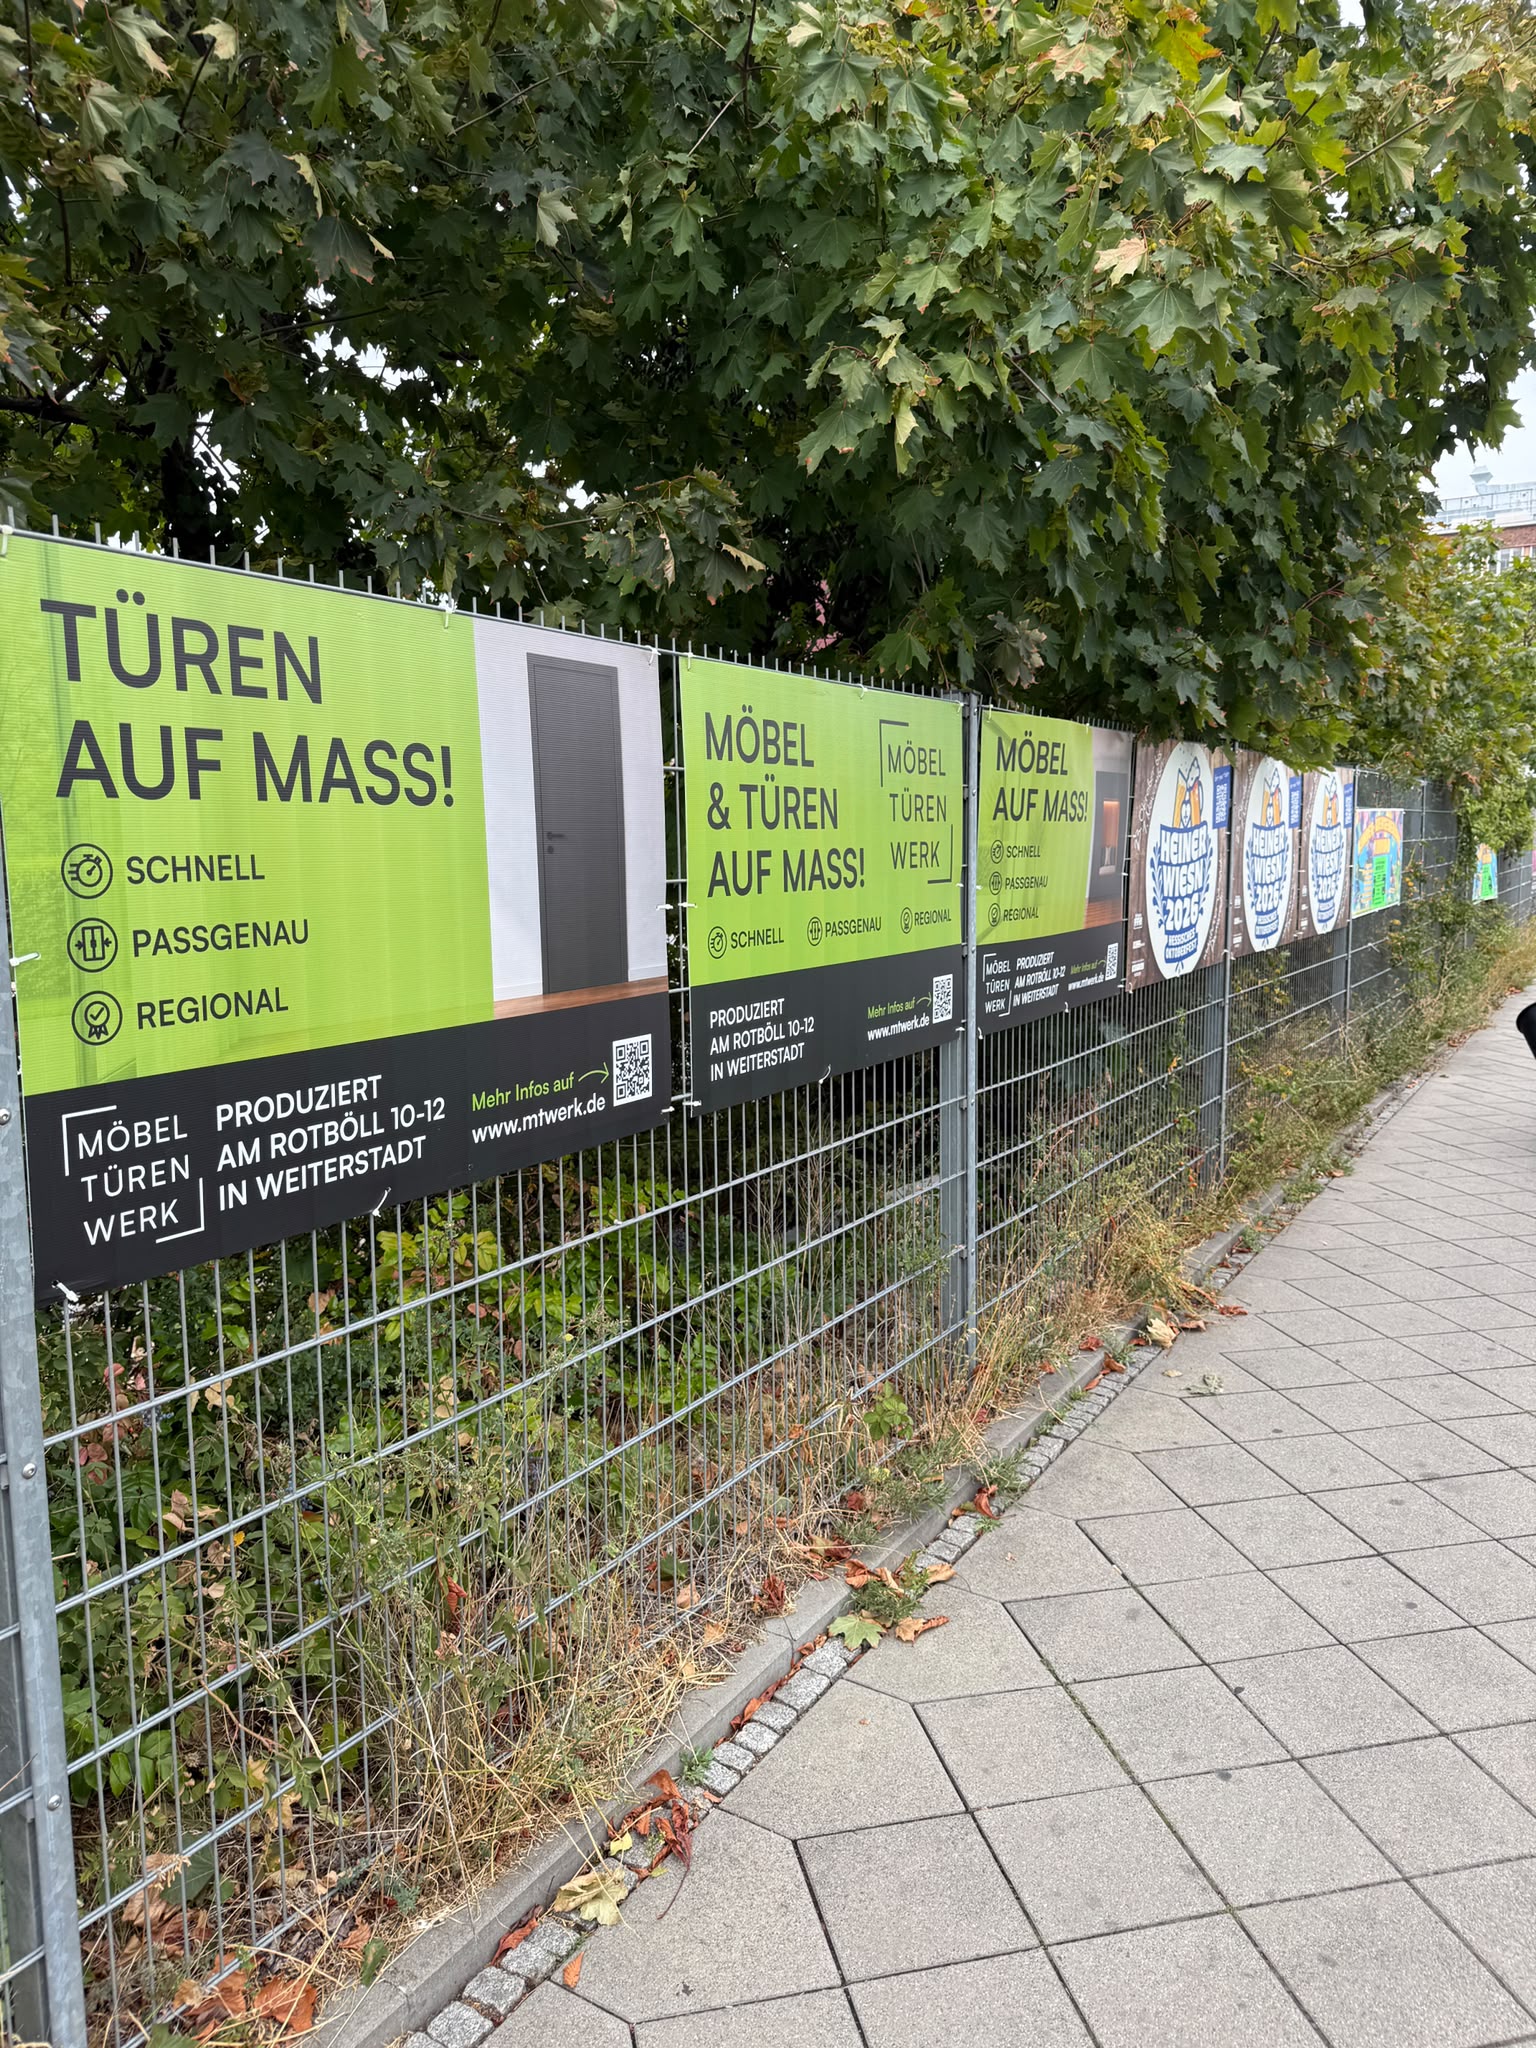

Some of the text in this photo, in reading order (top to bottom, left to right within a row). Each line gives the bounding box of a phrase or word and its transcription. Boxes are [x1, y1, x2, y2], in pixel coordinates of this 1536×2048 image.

[39, 589, 323, 705] TÜREN
[705, 704, 813, 768] MÖBEL
[996, 731, 1068, 775] MÖBEL
[56, 719, 454, 808] AUF MASS!
[888, 740, 946, 777] MÖBEL
[707, 775, 838, 830] & TÜREN
[889, 788, 947, 822] TÜREN
[993, 788, 1087, 822] AUF MASS!
[891, 841, 940, 870] WERK
[1006, 843, 1040, 859] SCHNELL
[1161, 827, 1206, 864] HEINER
[1253, 828, 1284, 856] HEINER
[126, 854, 265, 886] SCHNELL
[708, 847, 865, 898] AUF MASS!
[1005, 875, 1047, 890] PASSGENAU
[1163, 861, 1203, 897] WIESN
[1255, 855, 1282, 883] WIESN
[1003, 906, 1038, 922] REGIONAL
[1166, 894, 1199, 931] 2026
[1256, 881, 1279, 912] 2026
[825, 917, 881, 937] PASSGENAU
[914, 908, 951, 927] REGIONAL
[132, 919, 309, 958] PASSGENAU
[731, 927, 784, 949] SCHNELL
[986, 958, 1010, 976] MÖBEL
[1015, 976, 1025, 988] AM
[1026, 967, 1052, 986] ROTBÖLL
[1016, 952, 1053, 970] PRODUZIERT
[986, 975, 1010, 992] TÜREN
[1013, 984, 1058, 1007] IN WEITERSTADT
[136, 986, 288, 1029] REGIONAL
[710, 998, 784, 1027] PRODUZIERT
[868, 996, 915, 1019] Mehr Infos auf
[985, 998, 1005, 1014] WERK
[710, 1016, 814, 1056] AM ROTBÖLL 10-12
[868, 1013, 929, 1041] www.mtwerk.de
[711, 1043, 804, 1082] IN WEITERSTADT
[216, 1074, 381, 1132] PRODUZIERT
[471, 1072, 574, 1112] Mehr Infos auf
[216, 1097, 445, 1172] AM ROTBÖLL 10-12
[471, 1093, 606, 1145] www.mtwerk.de
[77, 1114, 188, 1160] MÖBEL
[81, 1154, 189, 1202] TÜREN
[218, 1136, 426, 1211] IN WEITERSTADT
[84, 1199, 180, 1246] WERK
